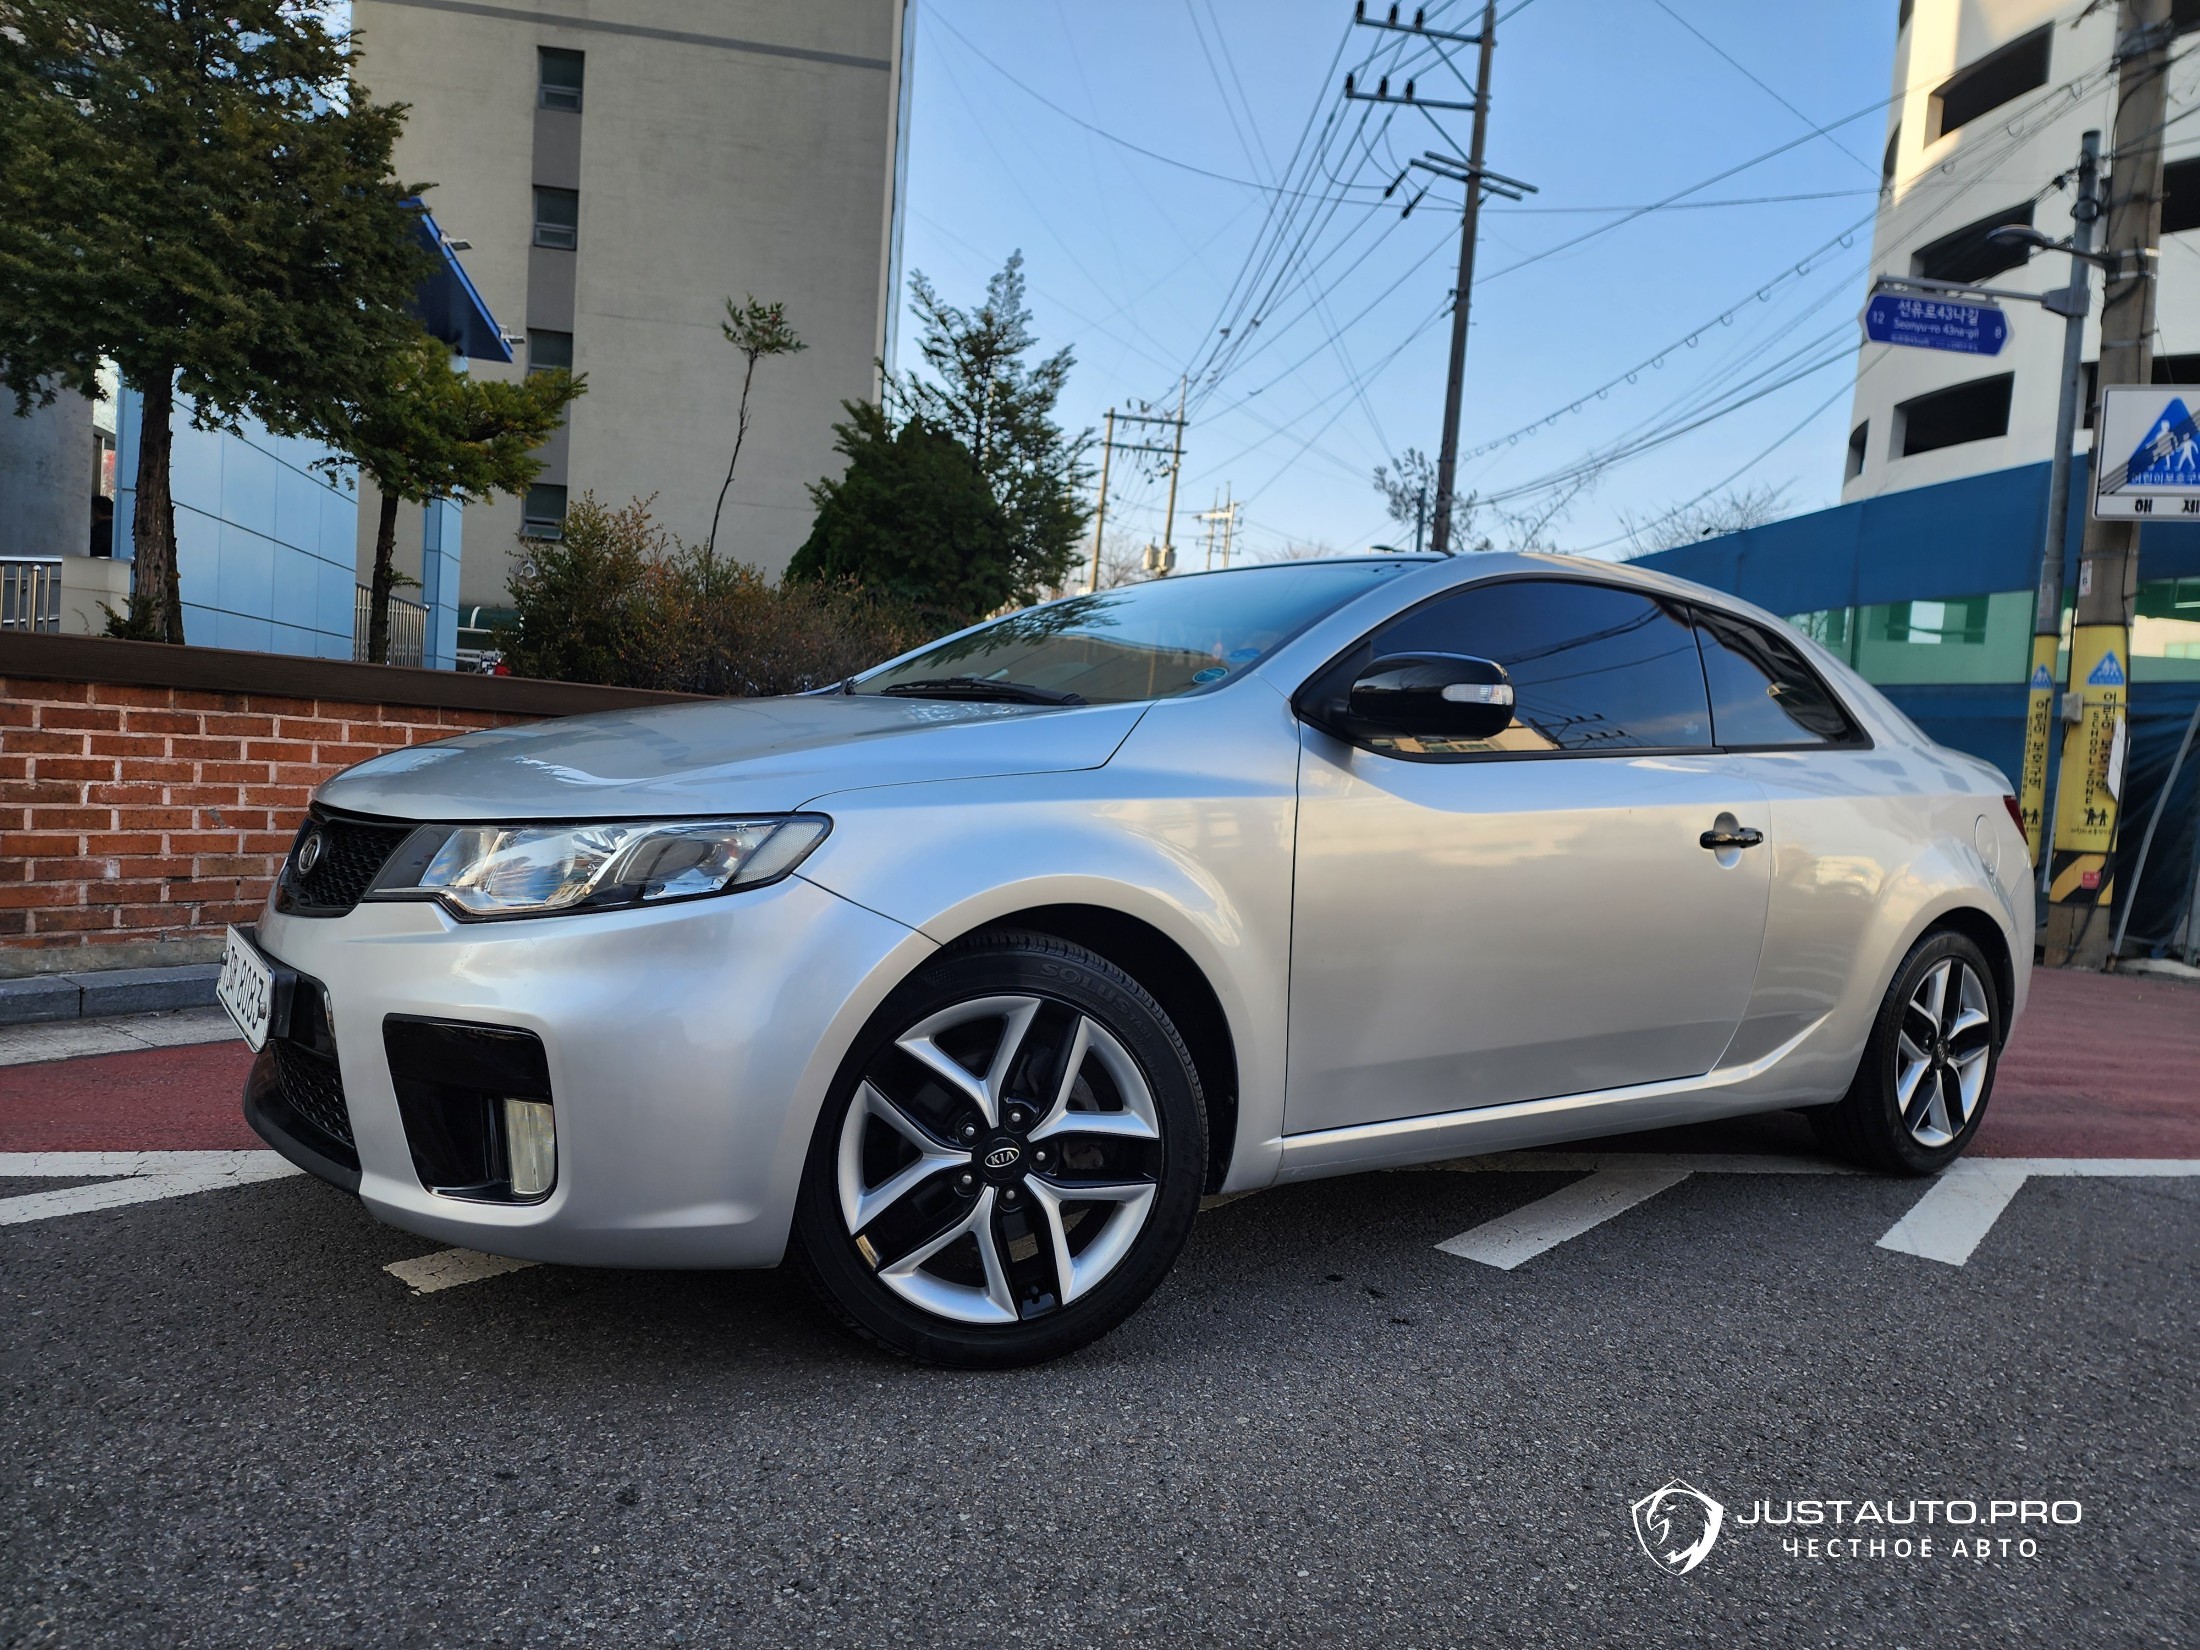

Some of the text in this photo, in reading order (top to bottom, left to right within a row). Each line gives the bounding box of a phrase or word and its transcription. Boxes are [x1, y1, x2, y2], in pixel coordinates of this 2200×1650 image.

[1873, 310, 1885, 325] 12
[1897, 300, 1979, 327] 선유로43나길
[1893, 317, 1941, 335] Seonyu-ro
[2131, 471, 2200, 486] 어린이보호구
[2089, 711, 2099, 765] SCHOOL
[236, 959, 264, 1030] 8083
[1040, 963, 1132, 1015] SOLUS
[990, 1150, 1015, 1165] KIA
